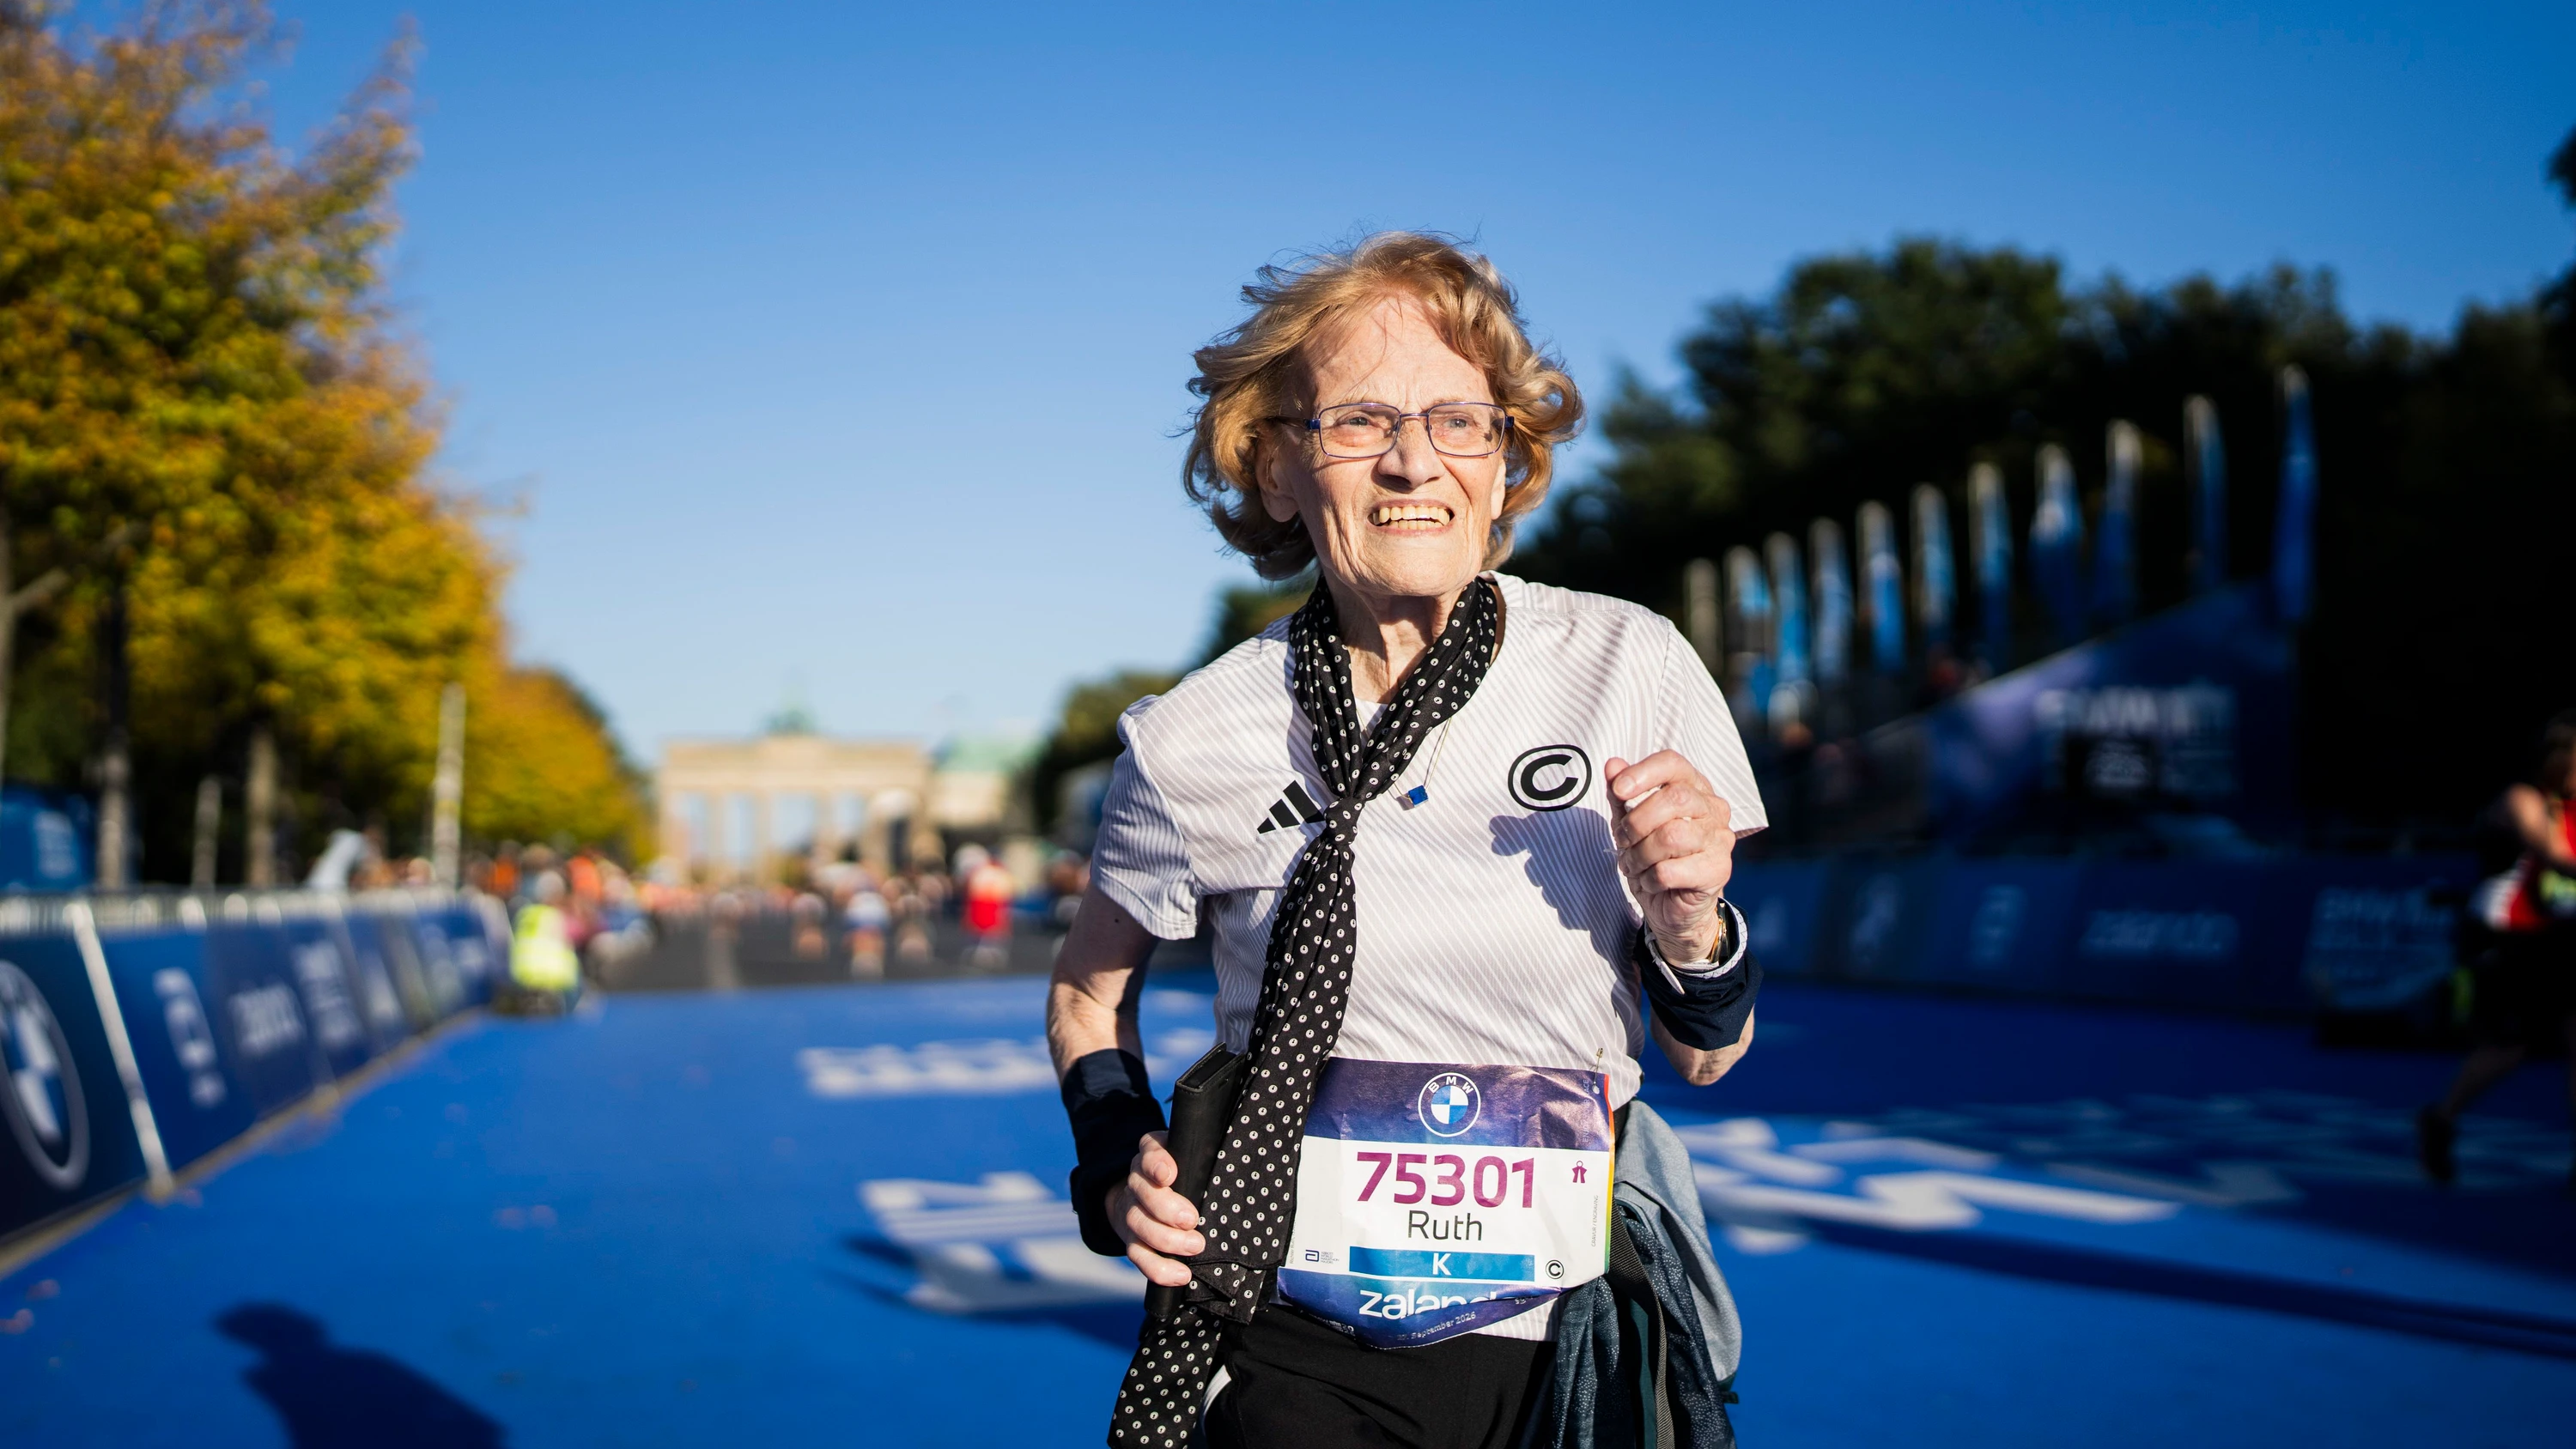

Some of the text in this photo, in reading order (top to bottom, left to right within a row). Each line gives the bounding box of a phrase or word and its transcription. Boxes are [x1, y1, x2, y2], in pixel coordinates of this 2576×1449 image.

[1427, 1076, 1474, 1094] BMW
[1357, 1151, 1535, 1209] 75301
[1407, 1210, 1483, 1241] Ruth
[1432, 1252, 1452, 1276] K
[1411, 1320, 1455, 1338] September
[1455, 1311, 1477, 1325] 2026
